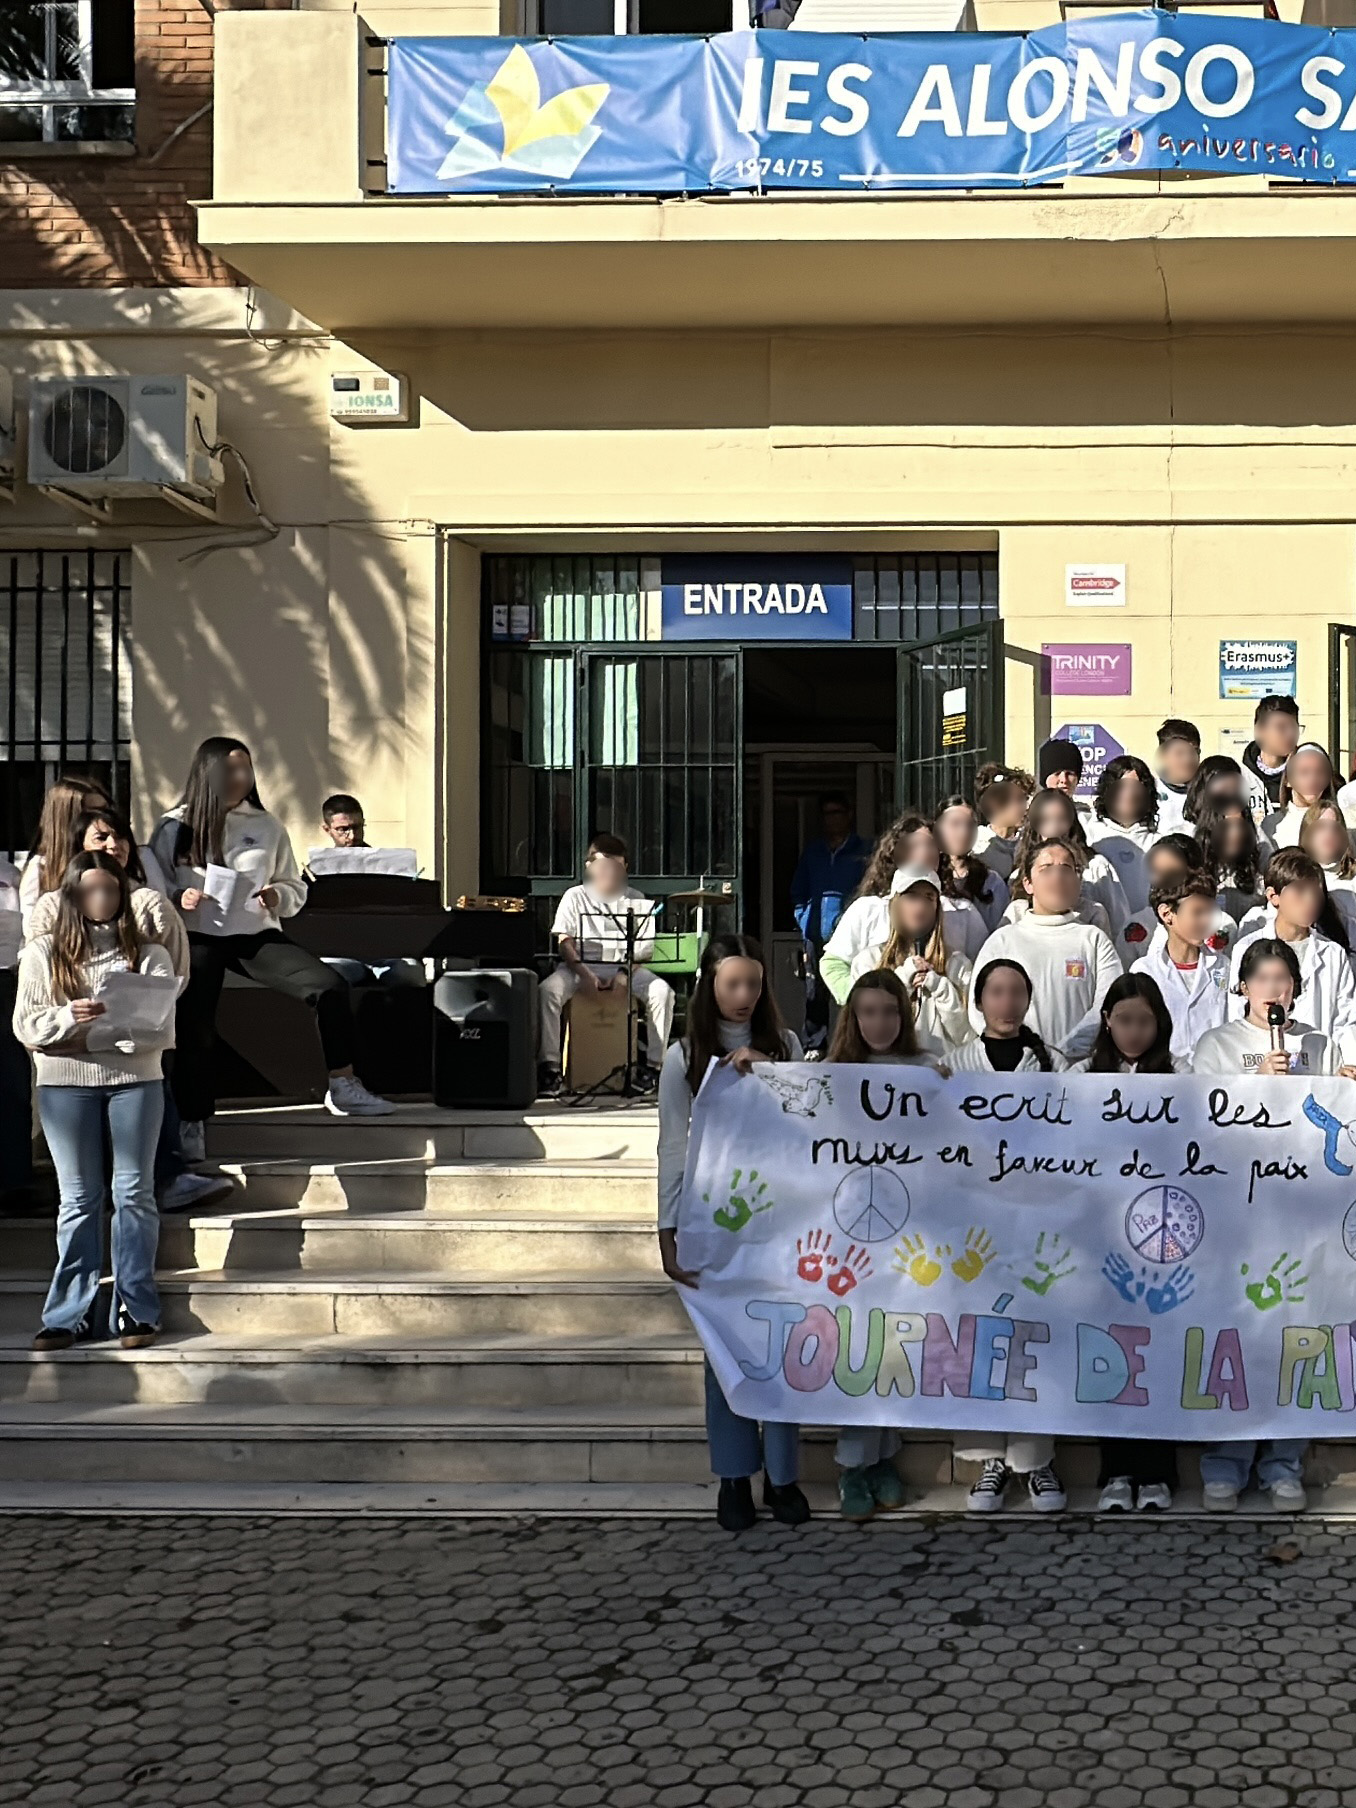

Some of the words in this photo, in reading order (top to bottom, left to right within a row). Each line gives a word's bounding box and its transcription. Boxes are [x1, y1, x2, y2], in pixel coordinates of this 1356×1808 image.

[735, 56, 871, 137] IES
[896, 37, 1255, 139] ALONSO
[1157, 124, 1335, 170] aniversario
[735, 158, 825, 179] 1974/75
[348, 394, 394, 408] IONSA
[684, 582, 828, 615] ENTRADA
[1051, 654, 1121, 670] TRINITY
[1227, 650, 1290, 663] Erasmus+
[860, 1079, 928, 1122] Un
[1208, 1088, 1292, 1128] les
[811, 1137, 924, 1166] murs
[936, 1140, 974, 1166] en
[988, 1139, 1103, 1182] faveur
[1119, 1149, 1166, 1179] de
[1177, 1141, 1229, 1176] la
[1248, 1155, 1308, 1204] paix
[738, 1293, 1051, 1402] JOURNÉE
[1075, 1322, 1152, 1407] DE
[1180, 1326, 1250, 1412] LA
